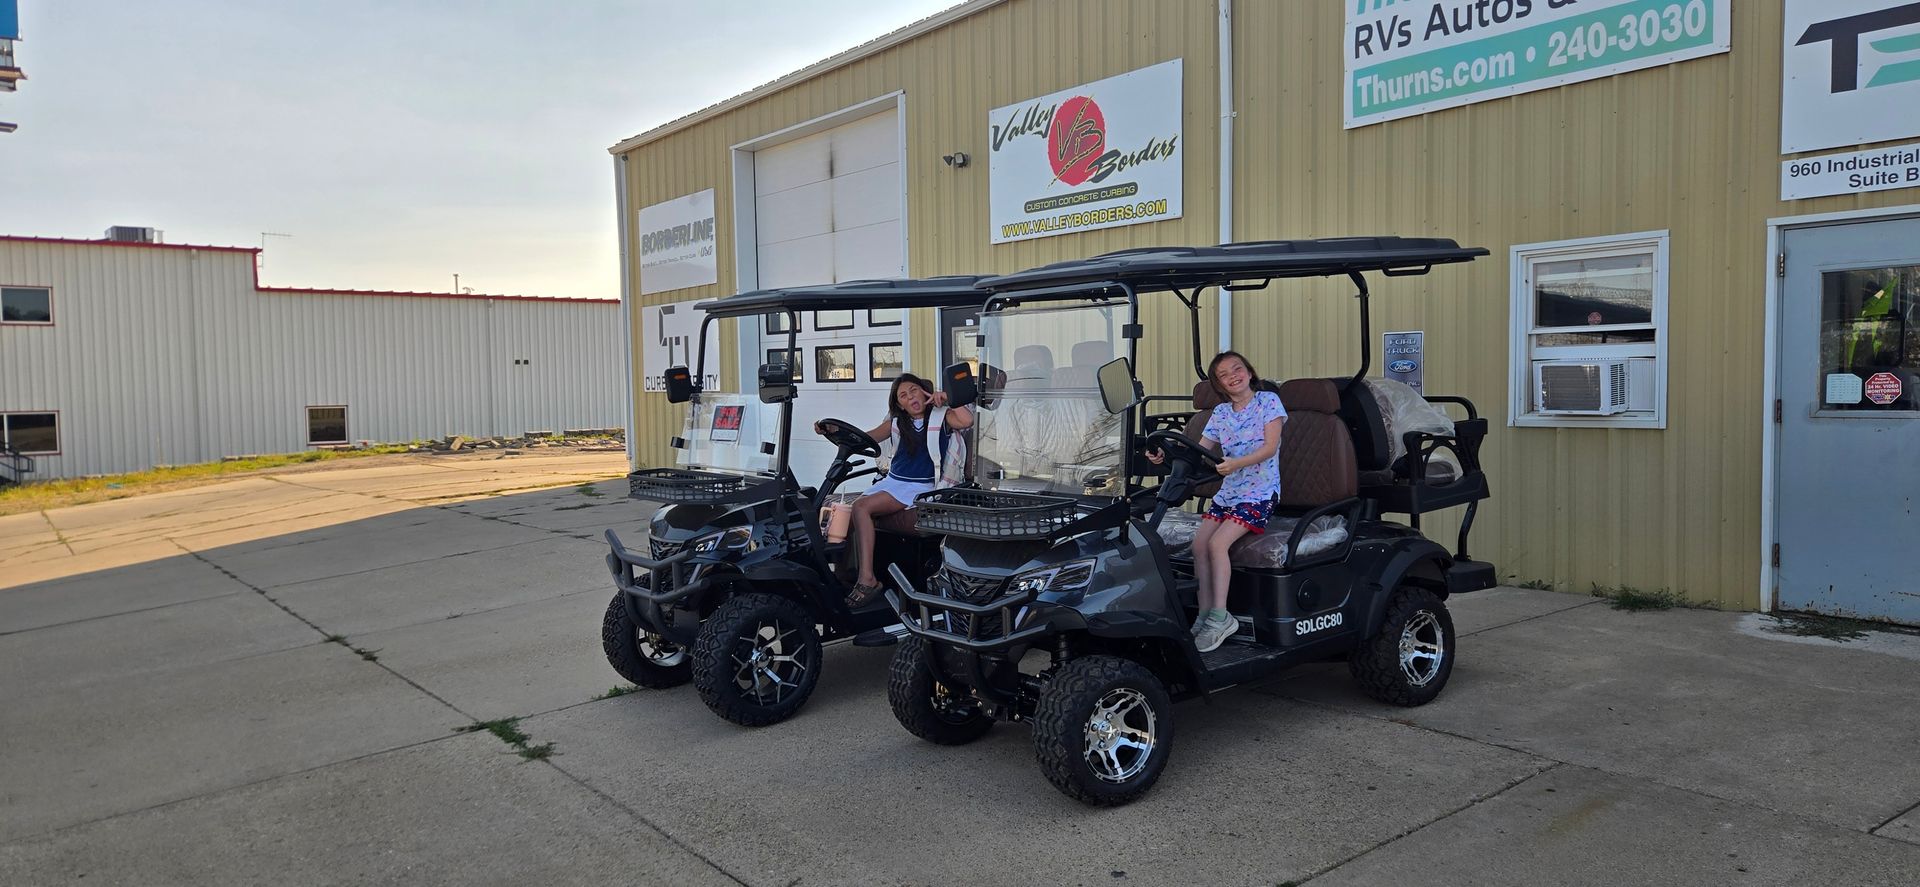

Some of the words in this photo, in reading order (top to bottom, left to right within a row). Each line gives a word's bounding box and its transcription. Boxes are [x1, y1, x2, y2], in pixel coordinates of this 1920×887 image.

[1354, 15, 1412, 59] RVs
[1423, 0, 1532, 42] Autos
[1356, 49, 1515, 107] Thurns.com
[1547, 3, 1707, 67] 240-3030
[992, 102, 1057, 152] Valley
[1085, 134, 1179, 184] Borders
[1790, 161, 1821, 178] 960
[1827, 149, 1920, 173] Industrial
[1848, 171, 1899, 188] Suite
[1906, 167, 1920, 182] B
[1026, 200, 1057, 211] CUSTOM
[1058, 192, 1099, 205] CONCRETE
[1100, 185, 1136, 198] CURBING
[641, 217, 714, 257] BORDERLINE
[1002, 199, 1168, 238] WWW.VALLEYBORDERS.COM
[715, 418, 740, 428] SALE
[1296, 612, 1342, 635] SDLGC80
